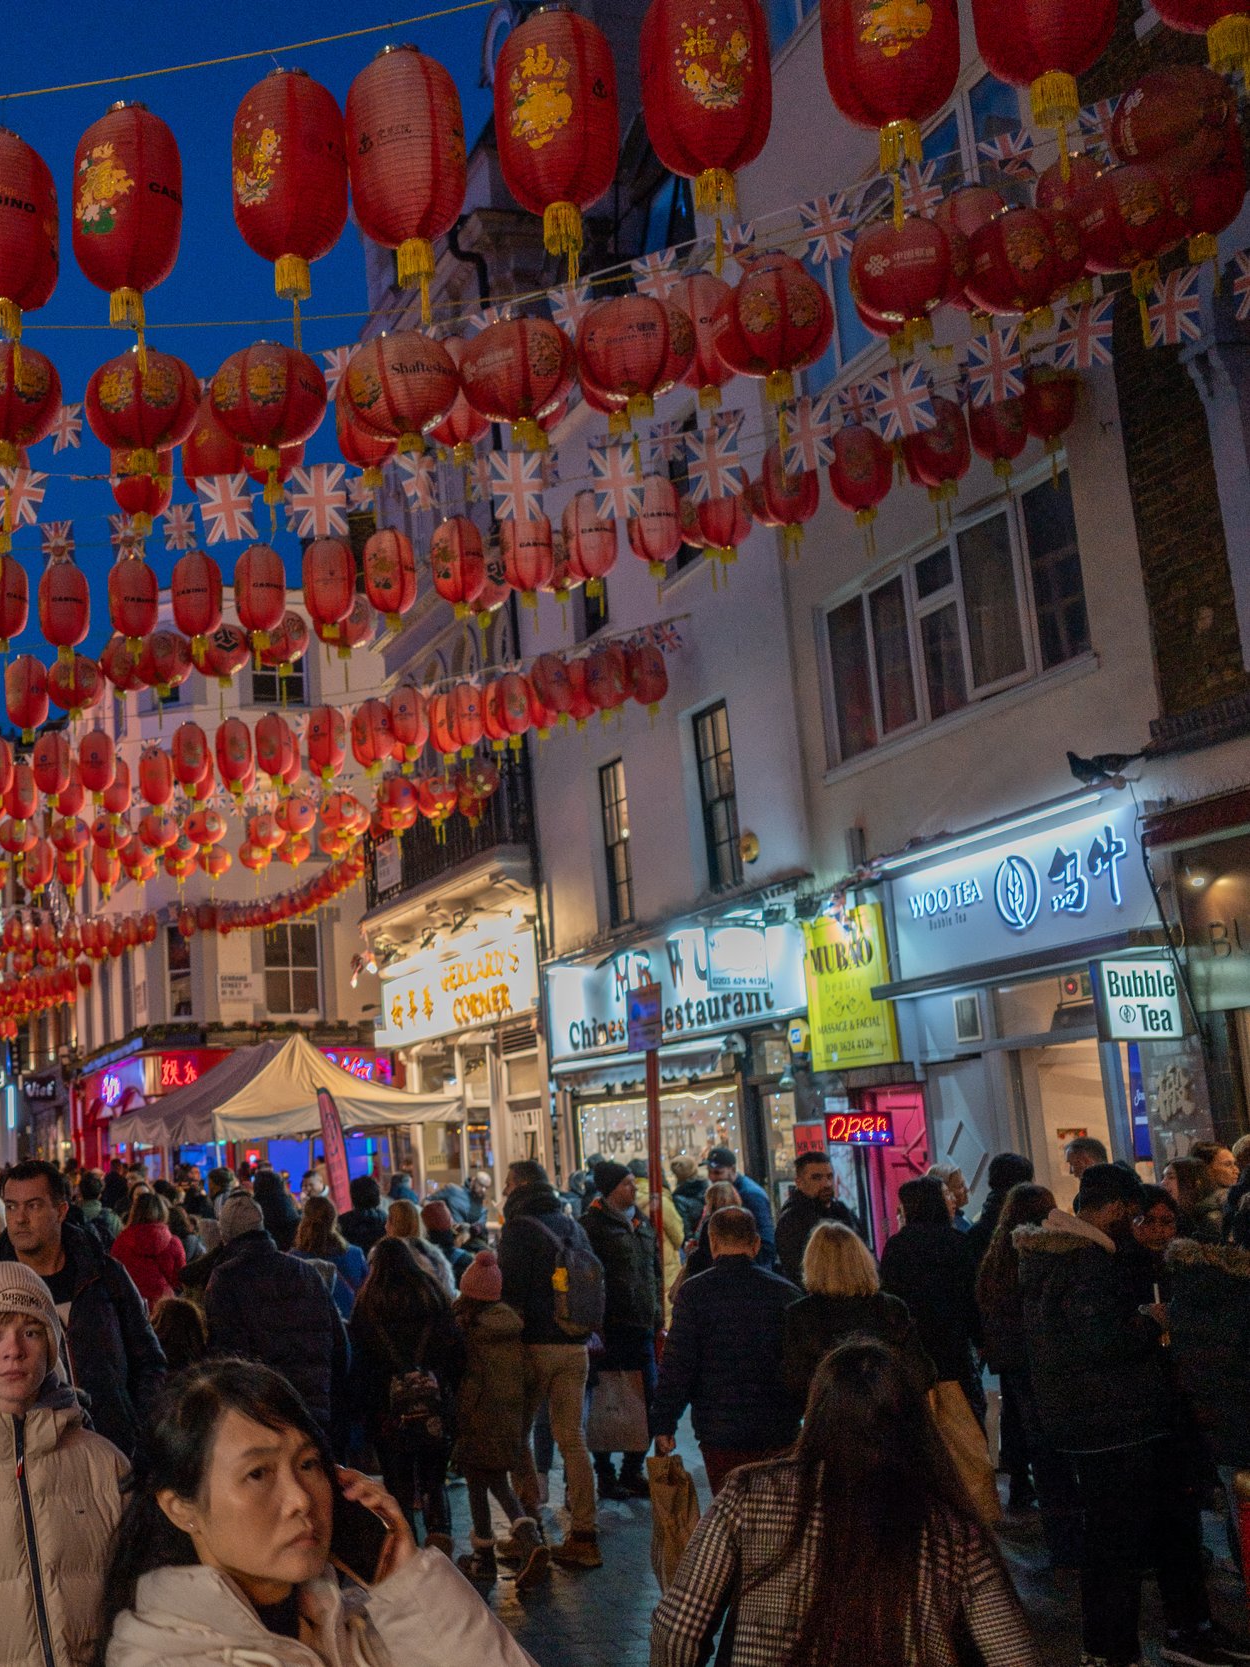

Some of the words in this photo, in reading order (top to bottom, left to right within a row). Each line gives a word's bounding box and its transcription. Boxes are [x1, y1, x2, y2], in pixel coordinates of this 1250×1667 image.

[908, 886, 951, 919] WOO
[953, 877, 984, 907] TEA
[929, 916, 953, 931] Bubble
[955, 913, 967, 925] Tea
[810, 937, 874, 976] MUBAO
[613, 949, 653, 1002] MR
[1107, 970, 1176, 997] Bubble
[568, 1017, 628, 1051] Chines
[661, 982, 775, 1033] estaurant
[818, 1020, 848, 1035] MASSAGE
[850, 1020, 856, 1031] &
[856, 1015, 881, 1030] FACIAL
[1136, 1004, 1174, 1032] Tea
[597, 1129, 626, 1154] HOT
[830, 1116, 887, 1142] Open
